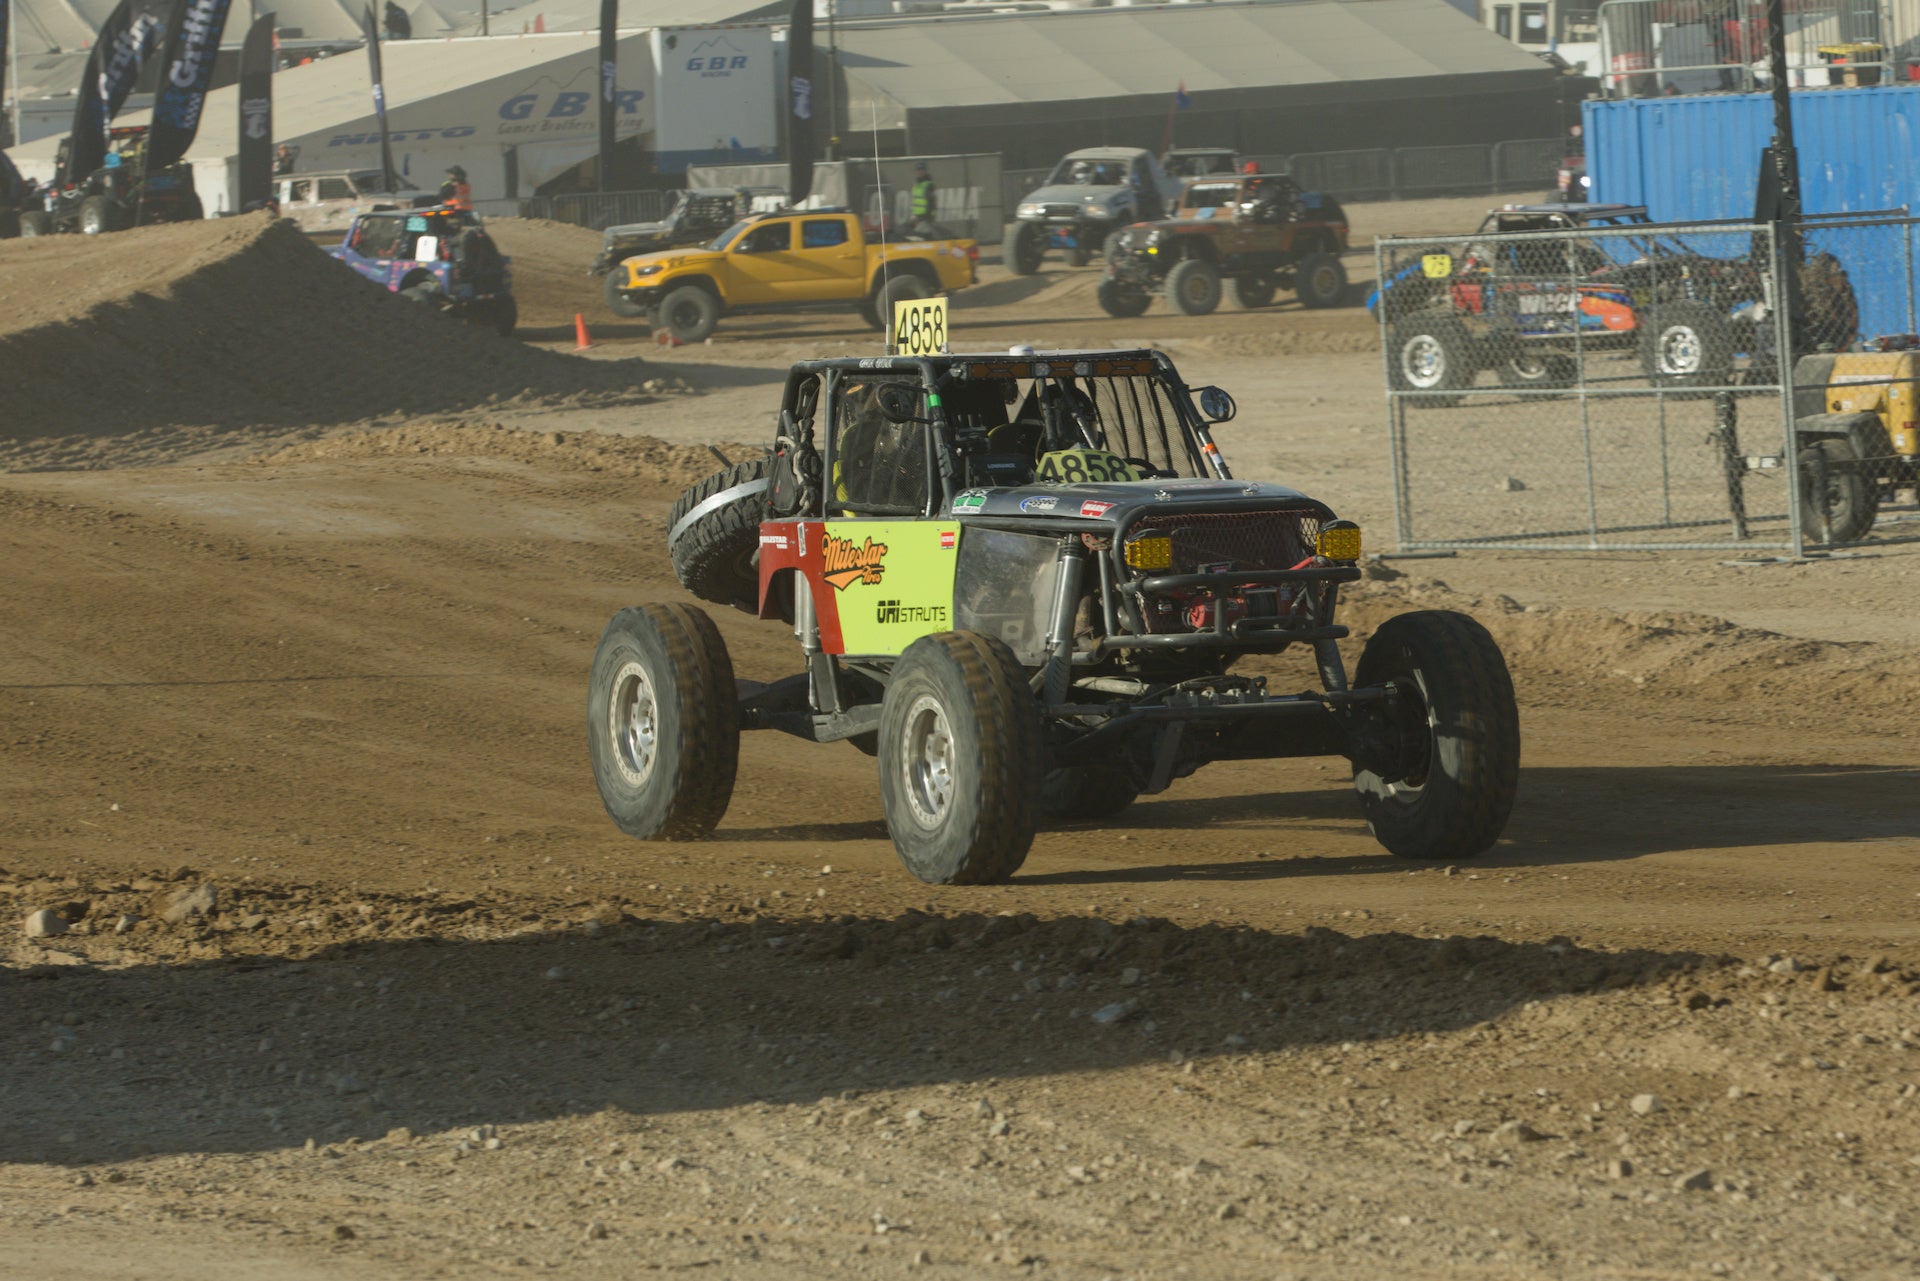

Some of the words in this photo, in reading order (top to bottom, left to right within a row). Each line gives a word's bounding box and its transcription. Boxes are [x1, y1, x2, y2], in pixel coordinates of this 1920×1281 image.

[687, 55, 749, 71] GBR
[327, 126, 476, 147] NITTO
[896, 304, 944, 353] 4858
[1040, 450, 1133, 484] 4858
[821, 531, 888, 574] Milestar
[862, 566, 885, 585] Tires
[900, 606, 947, 623] STRUTS
